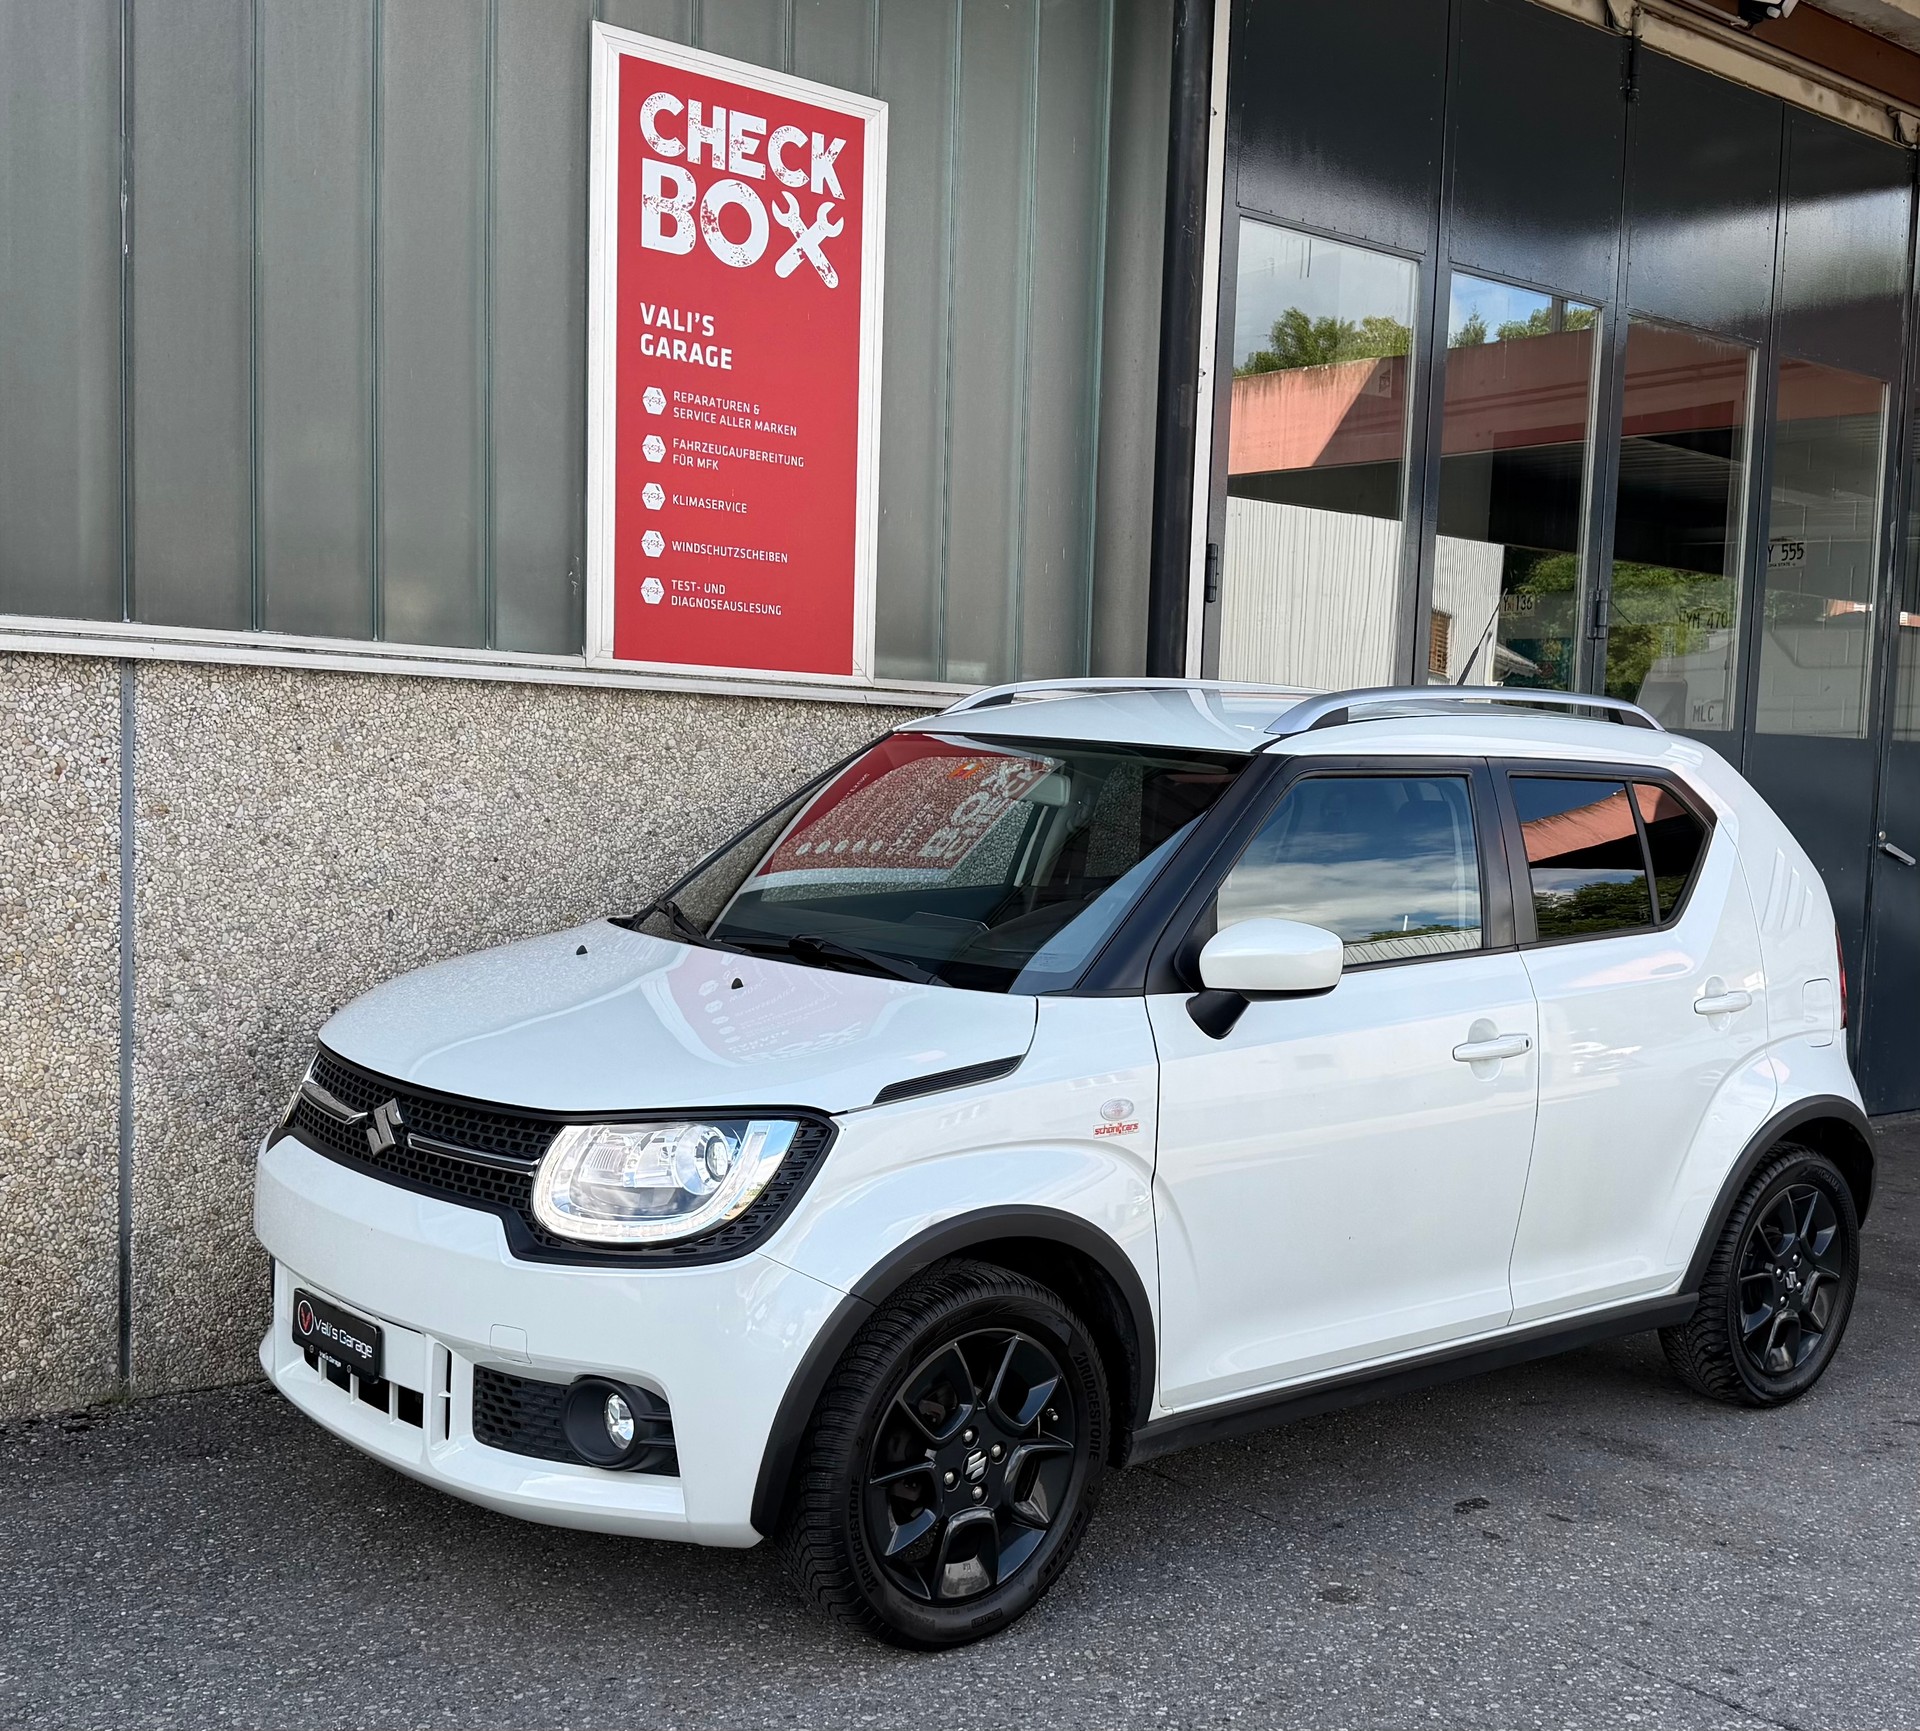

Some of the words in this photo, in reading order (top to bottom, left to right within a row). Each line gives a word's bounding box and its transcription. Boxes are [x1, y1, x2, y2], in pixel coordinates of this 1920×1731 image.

[640, 92, 846, 200] CHECK
[641, 157, 845, 288] BOX
[640, 333, 733, 370] GARAGE
[673, 390, 751, 413] REPARATUREN
[753, 404, 760, 415] &
[673, 407, 717, 424] SERVICE
[719, 415, 752, 430] ALLER
[754, 421, 797, 436] MARKEN
[672, 438, 804, 467] FAHRZEUGAUFBEREITUNG
[672, 453, 694, 467] FÜR
[697, 457, 719, 471] MFK
[672, 494, 748, 514] KLIMASERVICE
[671, 540, 788, 564] WINDSCHUTZSCHEIBEN
[1781, 542, 1804, 561] 555
[671, 579, 701, 592] TEST-
[704, 582, 726, 595] UND
[671, 595, 782, 616] DIAGNOSEAUSLESUNG
[1516, 594, 1533, 611] 136
[1706, 611, 1728, 629] 470
[313, 1316, 339, 1341] Vali's
[339, 1329, 373, 1359] Garage
[1073, 1351, 1102, 1461] BRIDGESTONE
[848, 1474, 879, 1594] BRIDGESTONE
